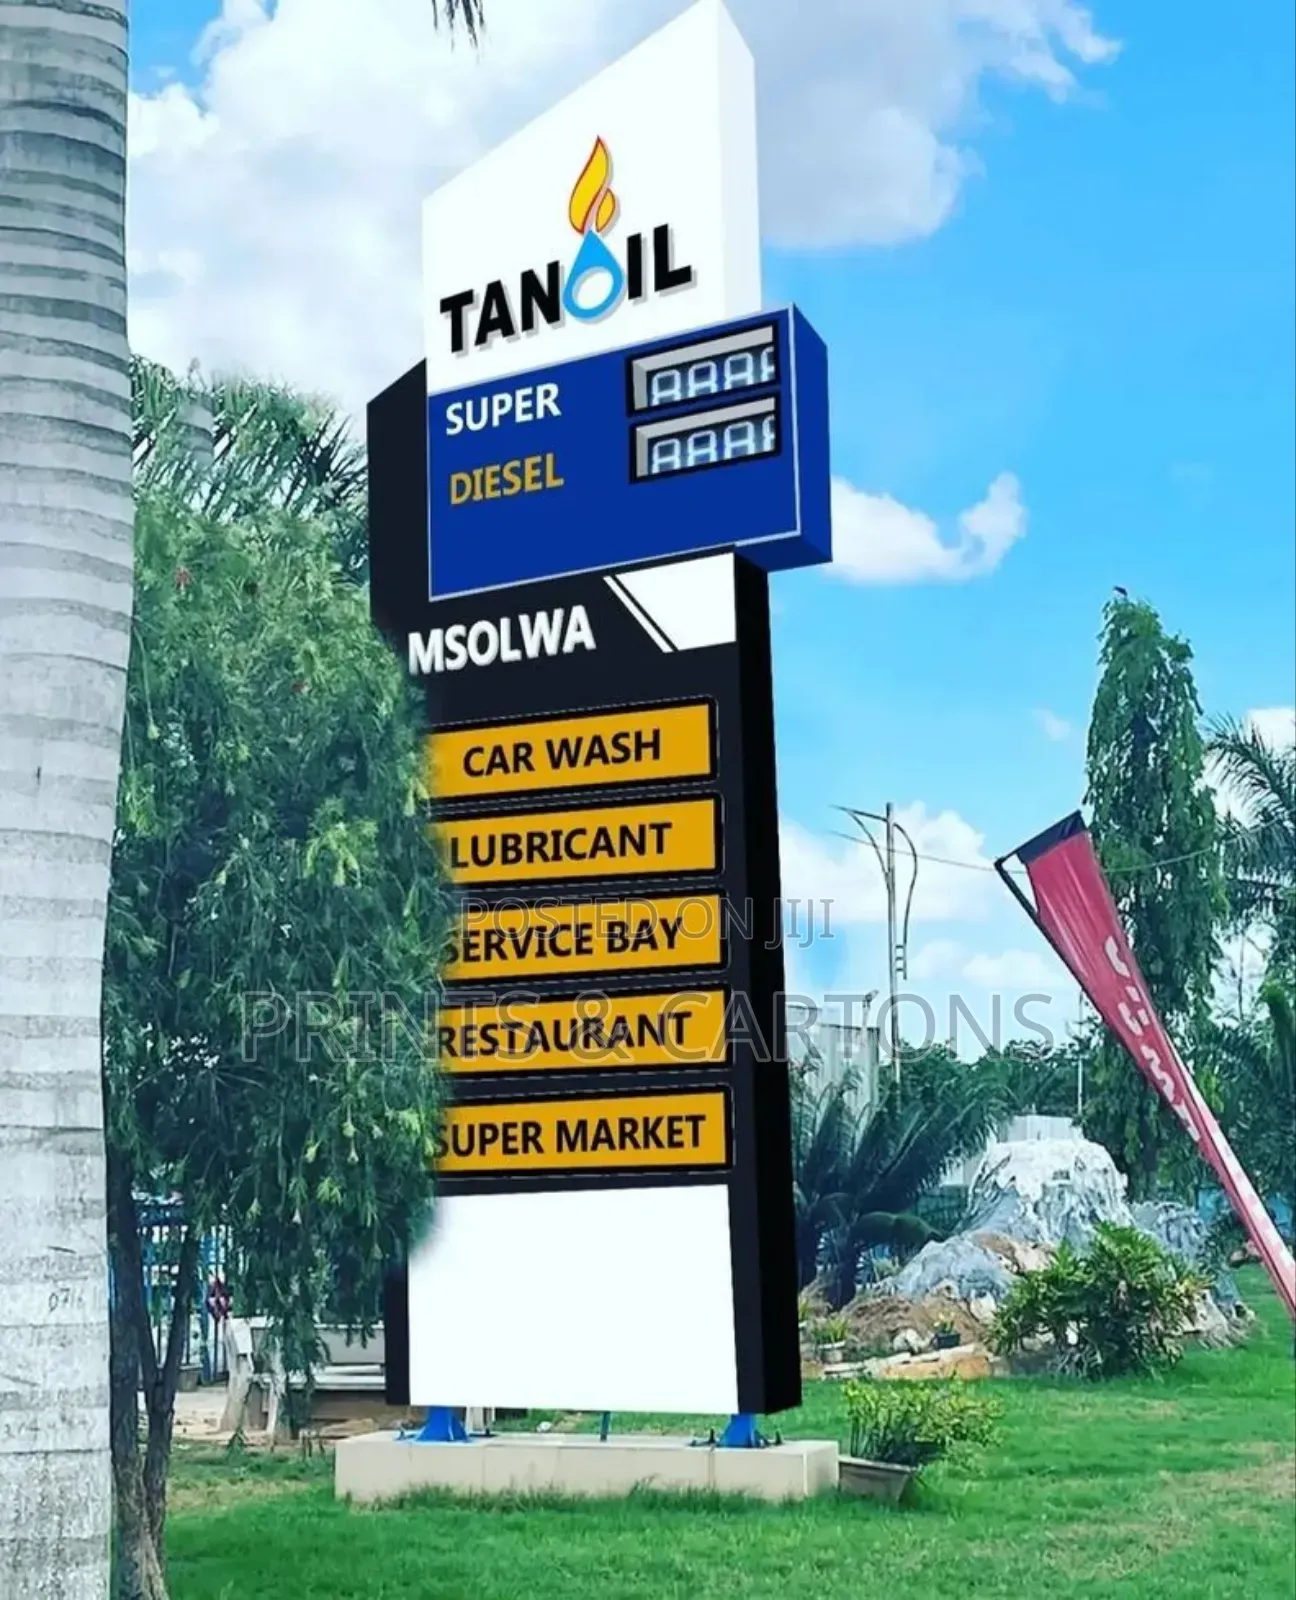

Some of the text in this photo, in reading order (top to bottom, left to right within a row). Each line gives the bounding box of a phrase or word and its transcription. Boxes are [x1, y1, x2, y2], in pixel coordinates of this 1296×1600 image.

[440, 223, 693, 354] TANOIL
[446, 383, 561, 436] SUPER
[449, 452, 564, 505] DIESEL
[408, 605, 597, 676] MSOLWA
[463, 728, 661, 778] CAR WASH
[450, 822, 673, 869] LUBRICANT
[606, 916, 683, 955] BAY
[438, 1011, 693, 1058] RESTAURANT
[433, 1114, 706, 1160] SUPER MARKET
